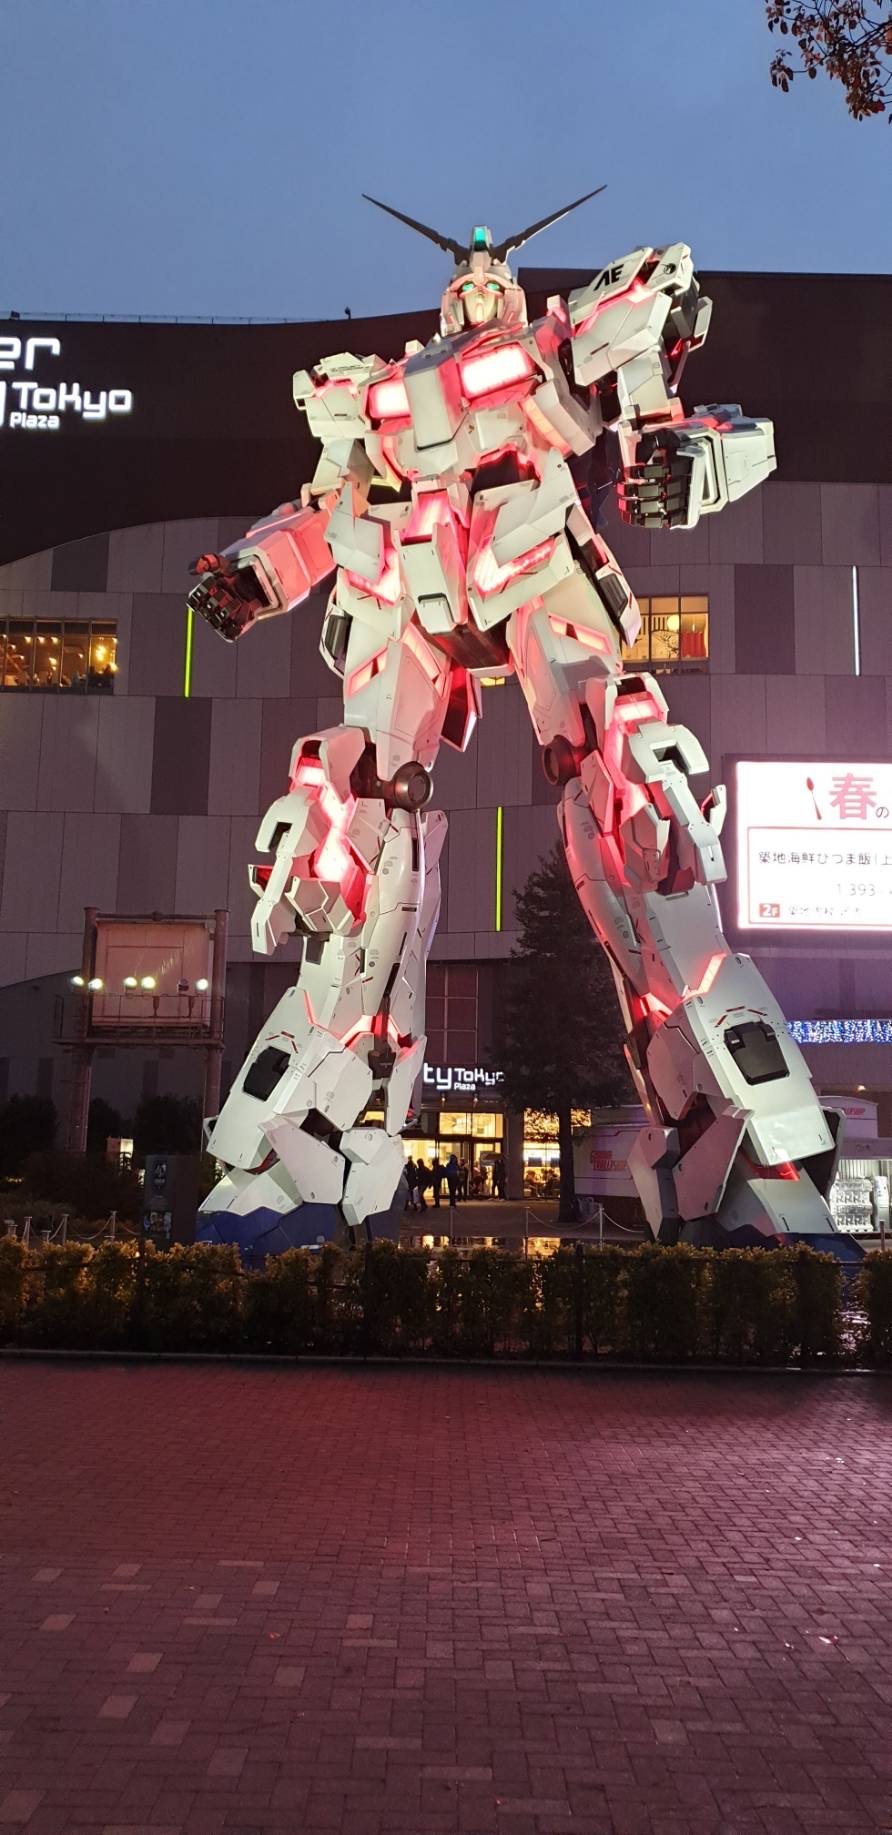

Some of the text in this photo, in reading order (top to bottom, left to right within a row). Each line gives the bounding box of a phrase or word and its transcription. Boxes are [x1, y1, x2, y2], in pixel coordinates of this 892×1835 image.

[11, 381, 133, 420] Tokyo
[10, 411, 61, 430] Plaza
[836, 882, 876, 896] 1393
[453, 1082, 476, 1091] Plaza
